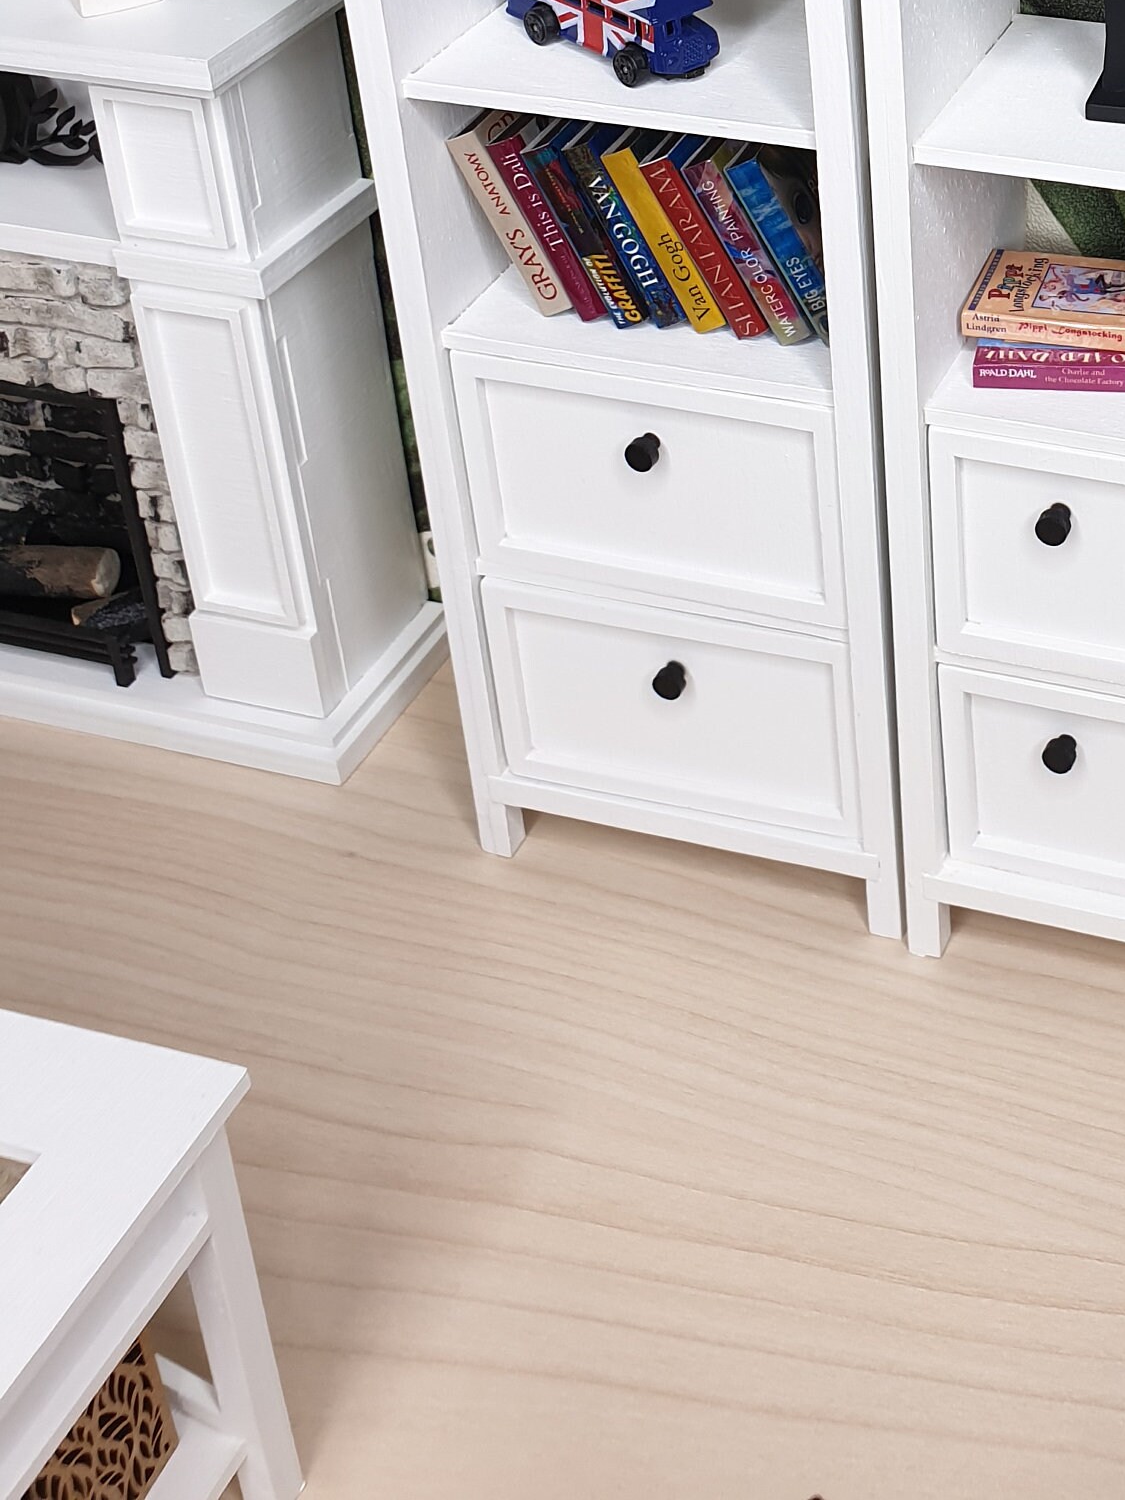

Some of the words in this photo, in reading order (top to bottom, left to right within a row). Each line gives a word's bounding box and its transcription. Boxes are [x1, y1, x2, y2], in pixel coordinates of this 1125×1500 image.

[464, 152, 511, 216] ANATOMY
[501, 152, 533, 191] Dali
[527, 193, 543, 209] is
[702, 179, 744, 244] PAINTING
[537, 210, 565, 252] This
[588, 176, 622, 220] VAN
[612, 222, 659, 288] GOGH
[506, 228, 558, 301] GRAY'S
[581, 257, 594, 267] OF
[649, 167, 759, 338] SHANTARAM
[657, 231, 691, 282] Gogh
[589, 268, 618, 310] EVOLUTION
[591, 254, 642, 322] GRAFFITI
[740, 247, 797, 338] WATERCOLOR
[786, 256, 812, 290] EYES
[1008, 258, 1049, 313] Longstocking
[613, 311, 626, 325] THE
[688, 284, 712, 322] Van
[802, 289, 826, 311] BIG
[966, 323, 1007, 334] Lindgren
[1017, 322, 1048, 333] Pippi
[1051, 324, 1123, 342] Longstocking
[979, 368, 1007, 377] ROALD
[1008, 369, 1037, 379] DAHL
[1045, 374, 1057, 382] the
[1058, 376, 1096, 384] Chocolate
[1097, 378, 1124, 387] Factory
[1061, 367, 1090, 376] Charlie
